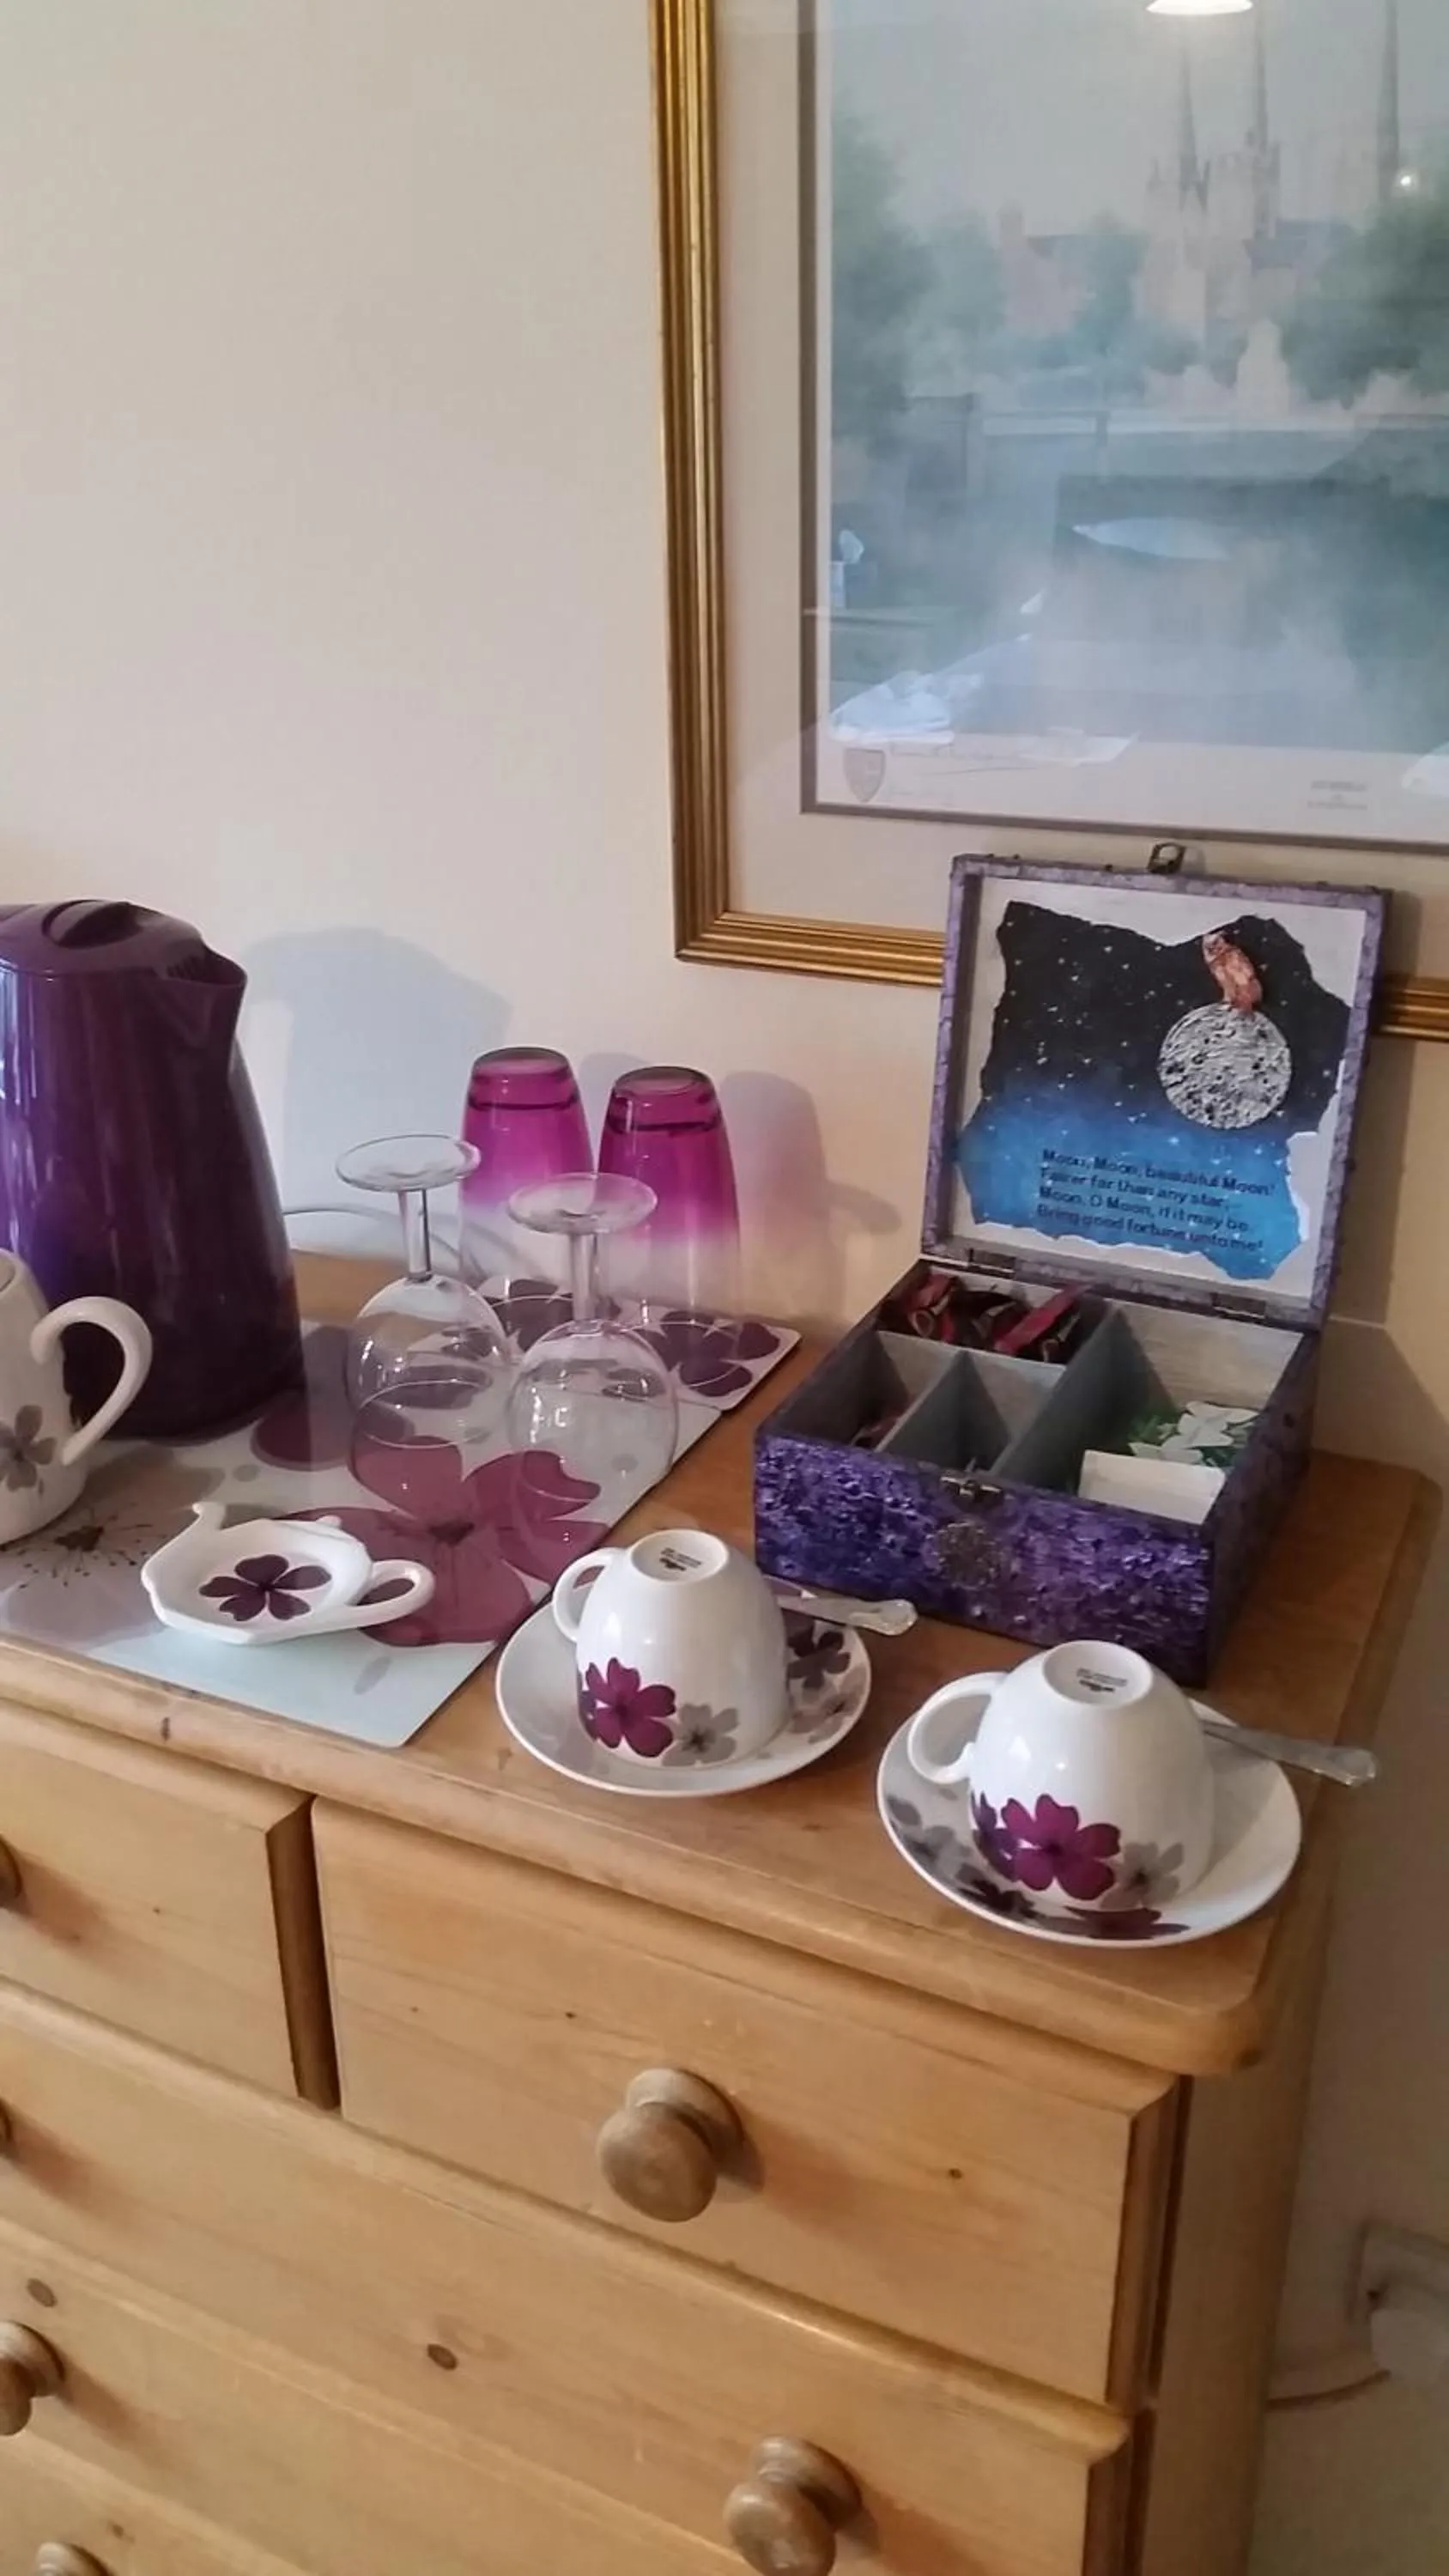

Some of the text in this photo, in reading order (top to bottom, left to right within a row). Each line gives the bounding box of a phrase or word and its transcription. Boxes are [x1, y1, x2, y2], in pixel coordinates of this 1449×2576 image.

[1090, 1174, 1115, 1188] far
[1156, 1188, 1188, 1204] any
[1089, 1194, 1102, 1207] O
